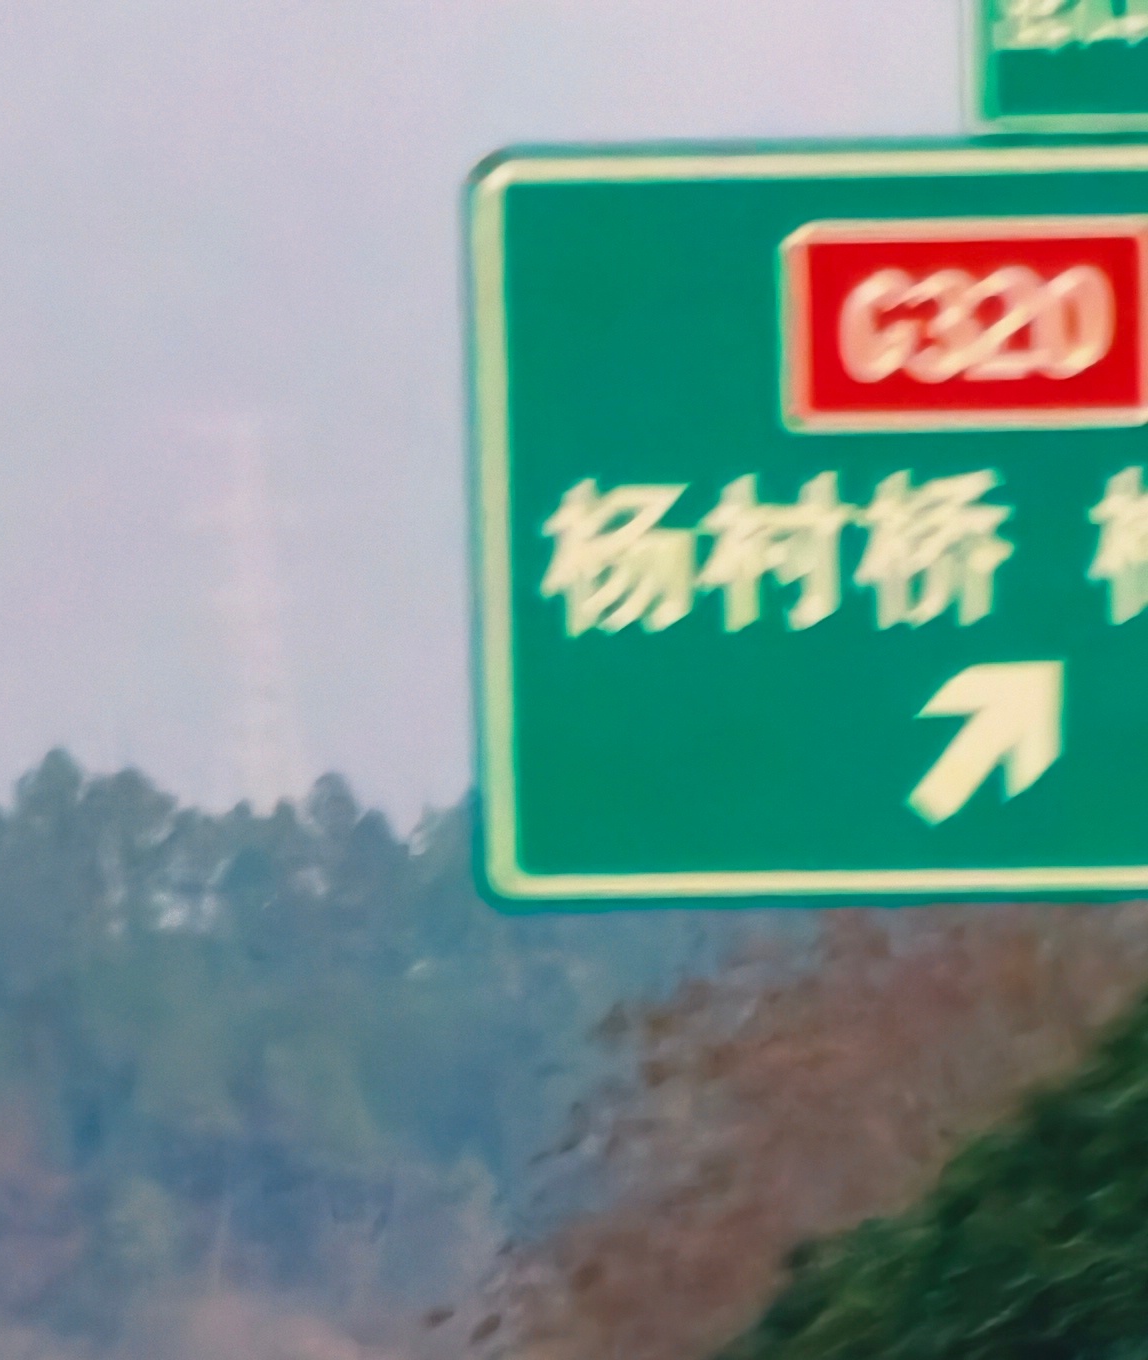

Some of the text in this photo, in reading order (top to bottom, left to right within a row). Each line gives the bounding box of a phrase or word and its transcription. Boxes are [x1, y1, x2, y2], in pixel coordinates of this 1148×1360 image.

[838, 264, 1116, 384] G320
[540, 468, 1015, 638] 杨村桥
